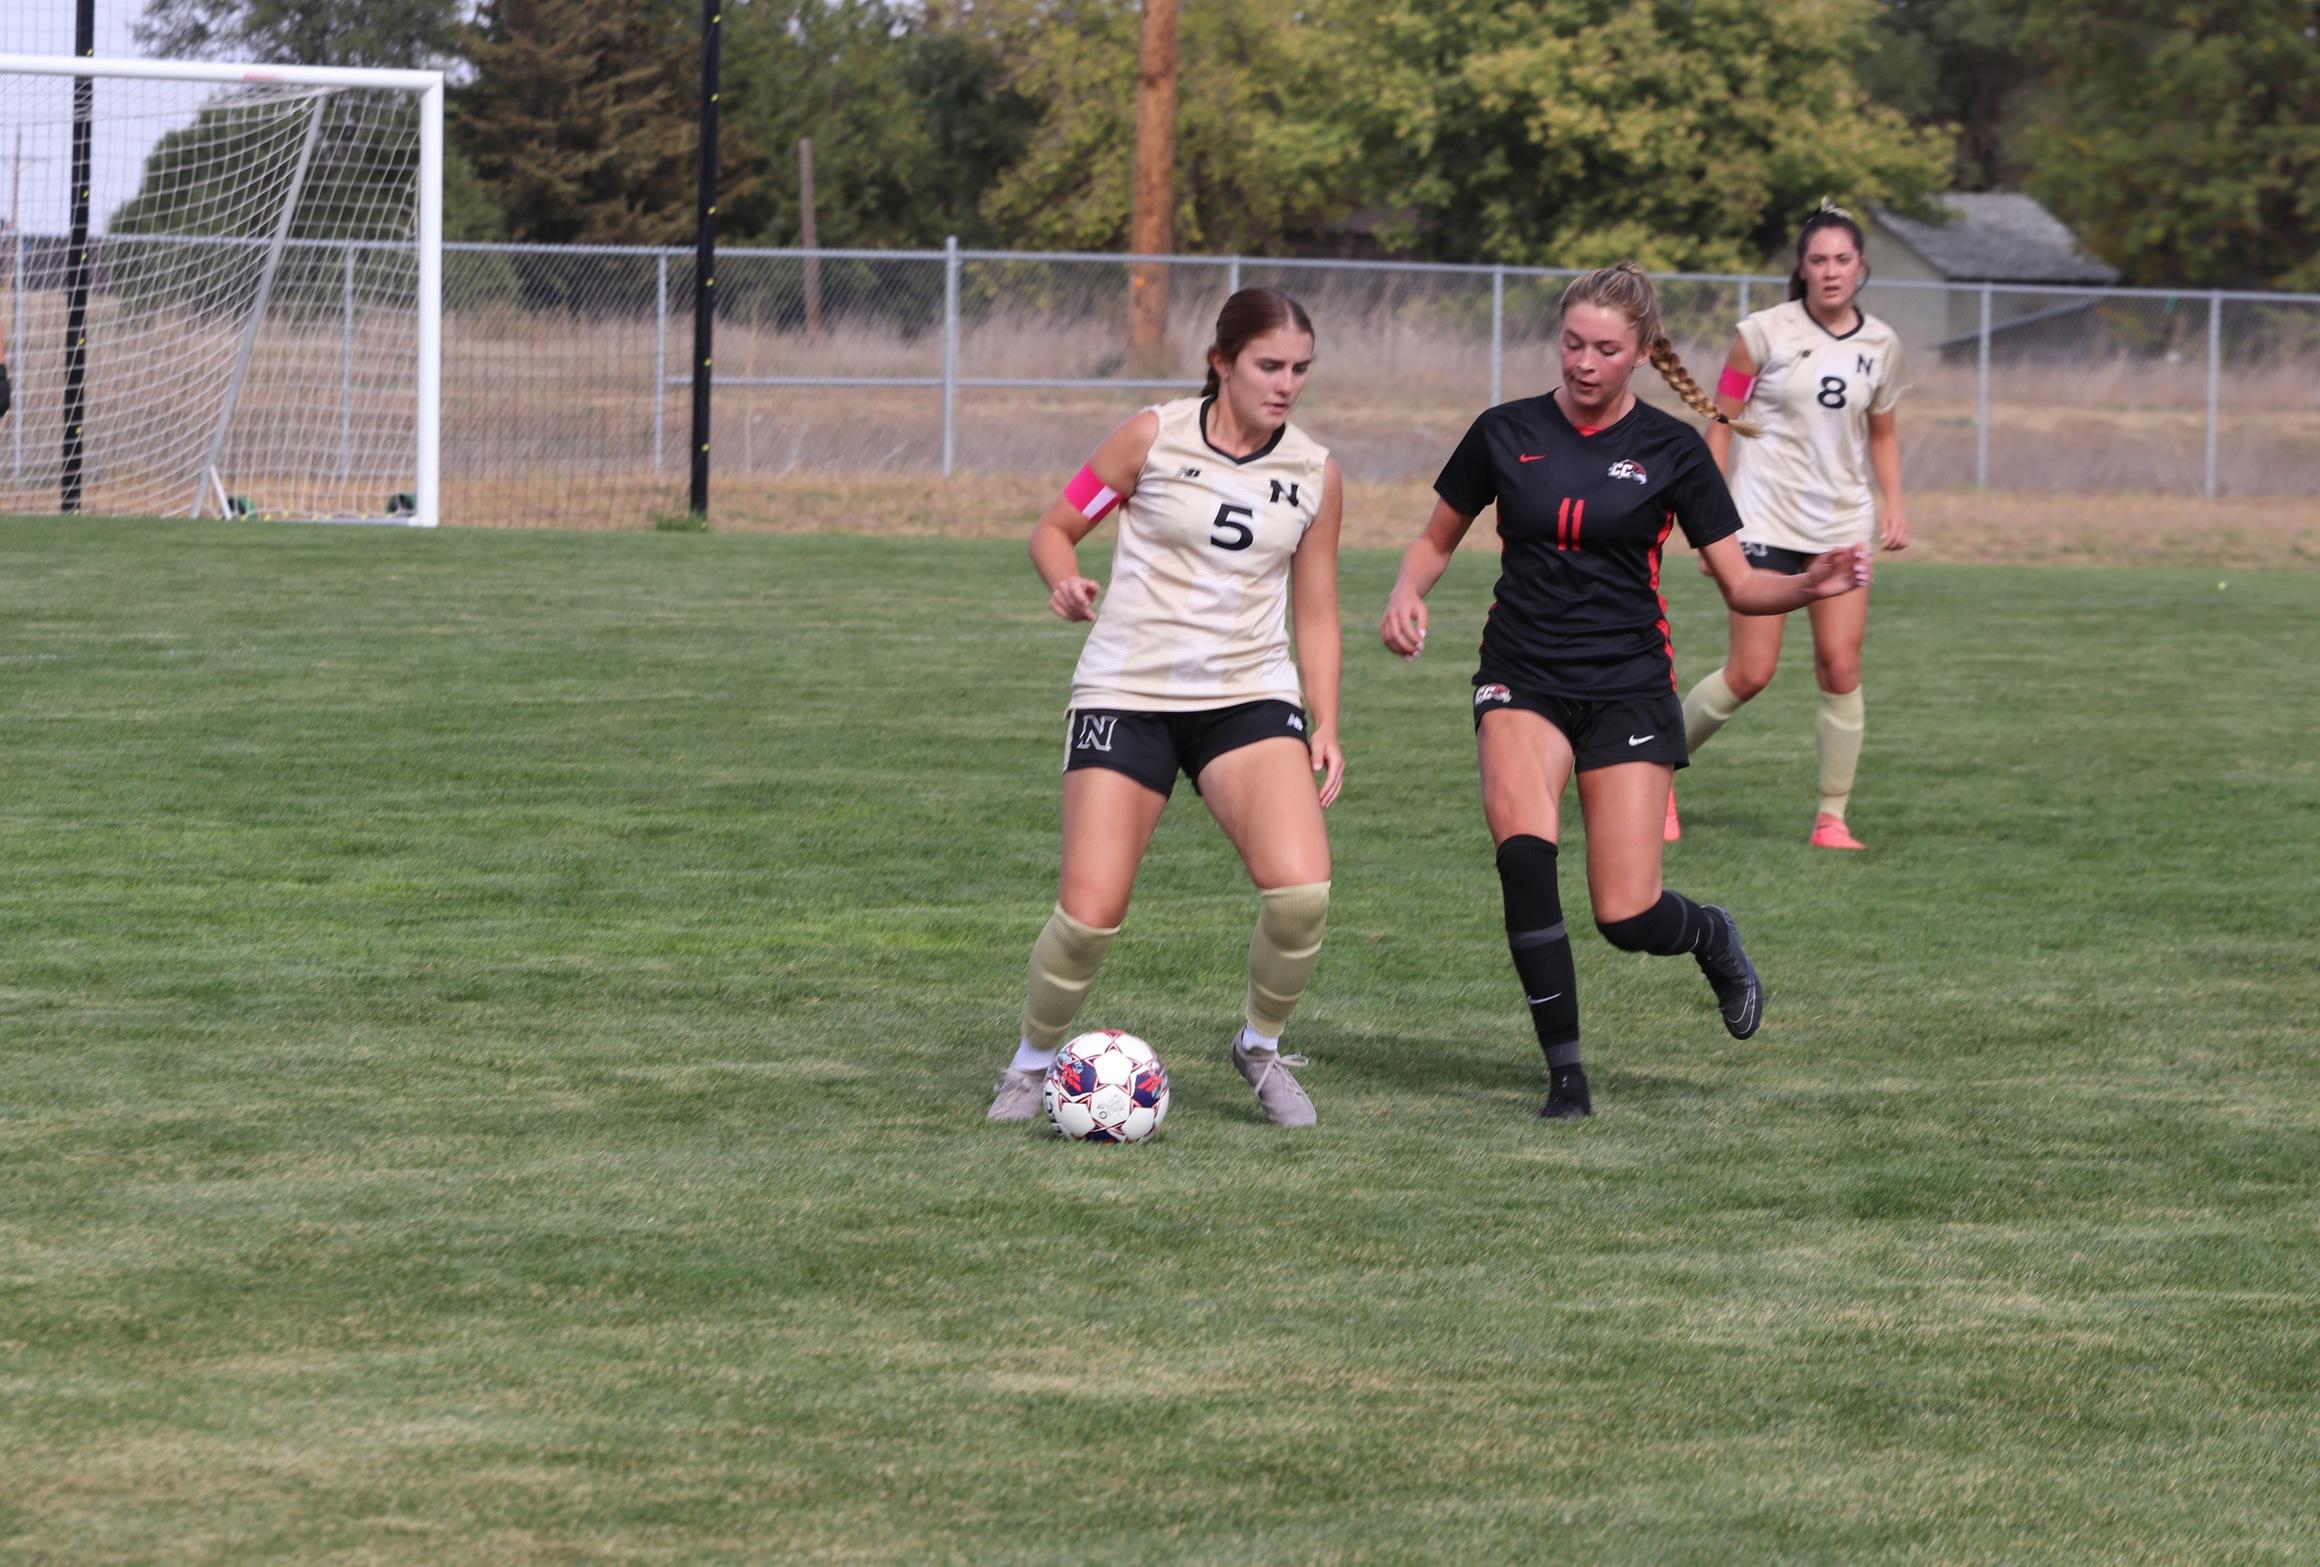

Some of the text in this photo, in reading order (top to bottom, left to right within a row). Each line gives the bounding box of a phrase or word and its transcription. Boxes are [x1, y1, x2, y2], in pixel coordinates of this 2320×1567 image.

[1856, 353, 1874, 376] N
[1817, 376, 1847, 409] 8
[1269, 479, 1300, 507] N
[1210, 502, 1254, 551] 5
[1557, 497, 1586, 551] 11
[1076, 714, 1118, 751] N
